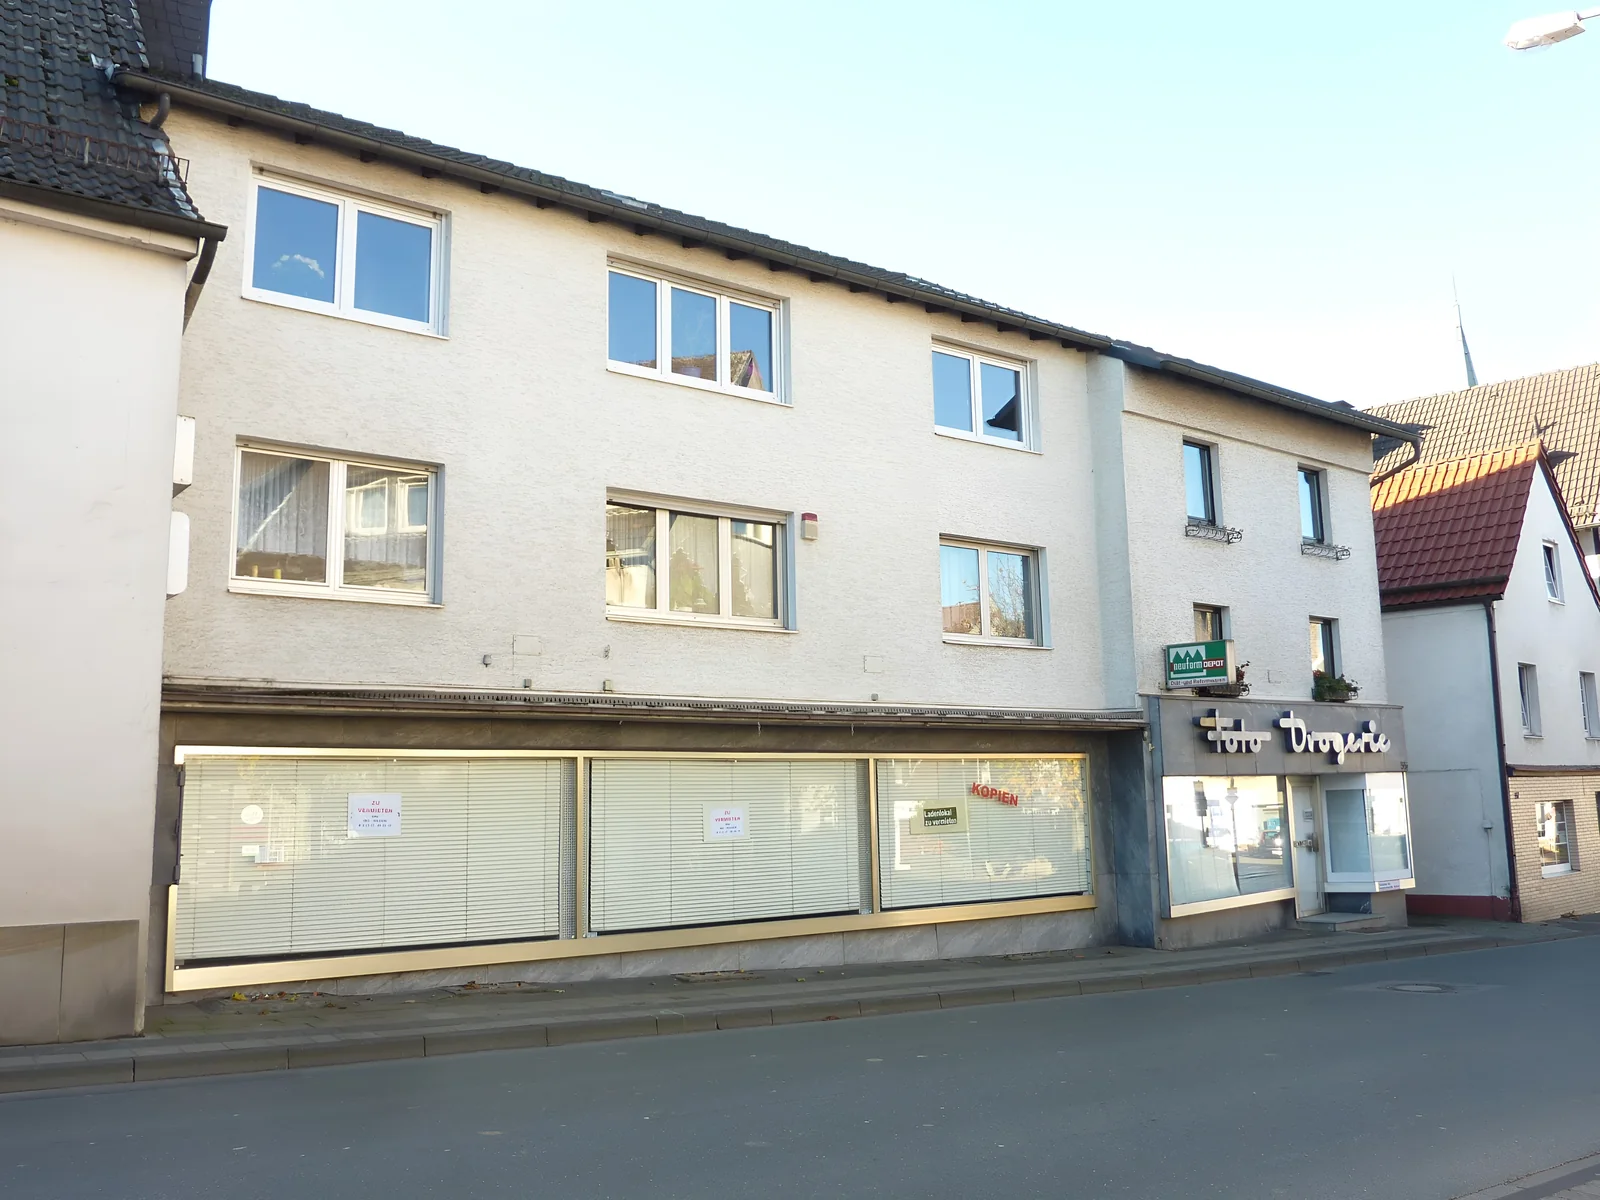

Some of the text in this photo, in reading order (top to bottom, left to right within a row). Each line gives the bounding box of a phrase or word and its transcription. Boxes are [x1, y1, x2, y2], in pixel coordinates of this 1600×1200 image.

[1174, 657, 1224, 671] neuform DEPOT
[1196, 708, 1391, 765] Foto Drogerie
[971, 782, 1019, 806] KOPIEN
[924, 808, 952, 818] Ladenlokal
[933, 818, 957, 826] vermieten
